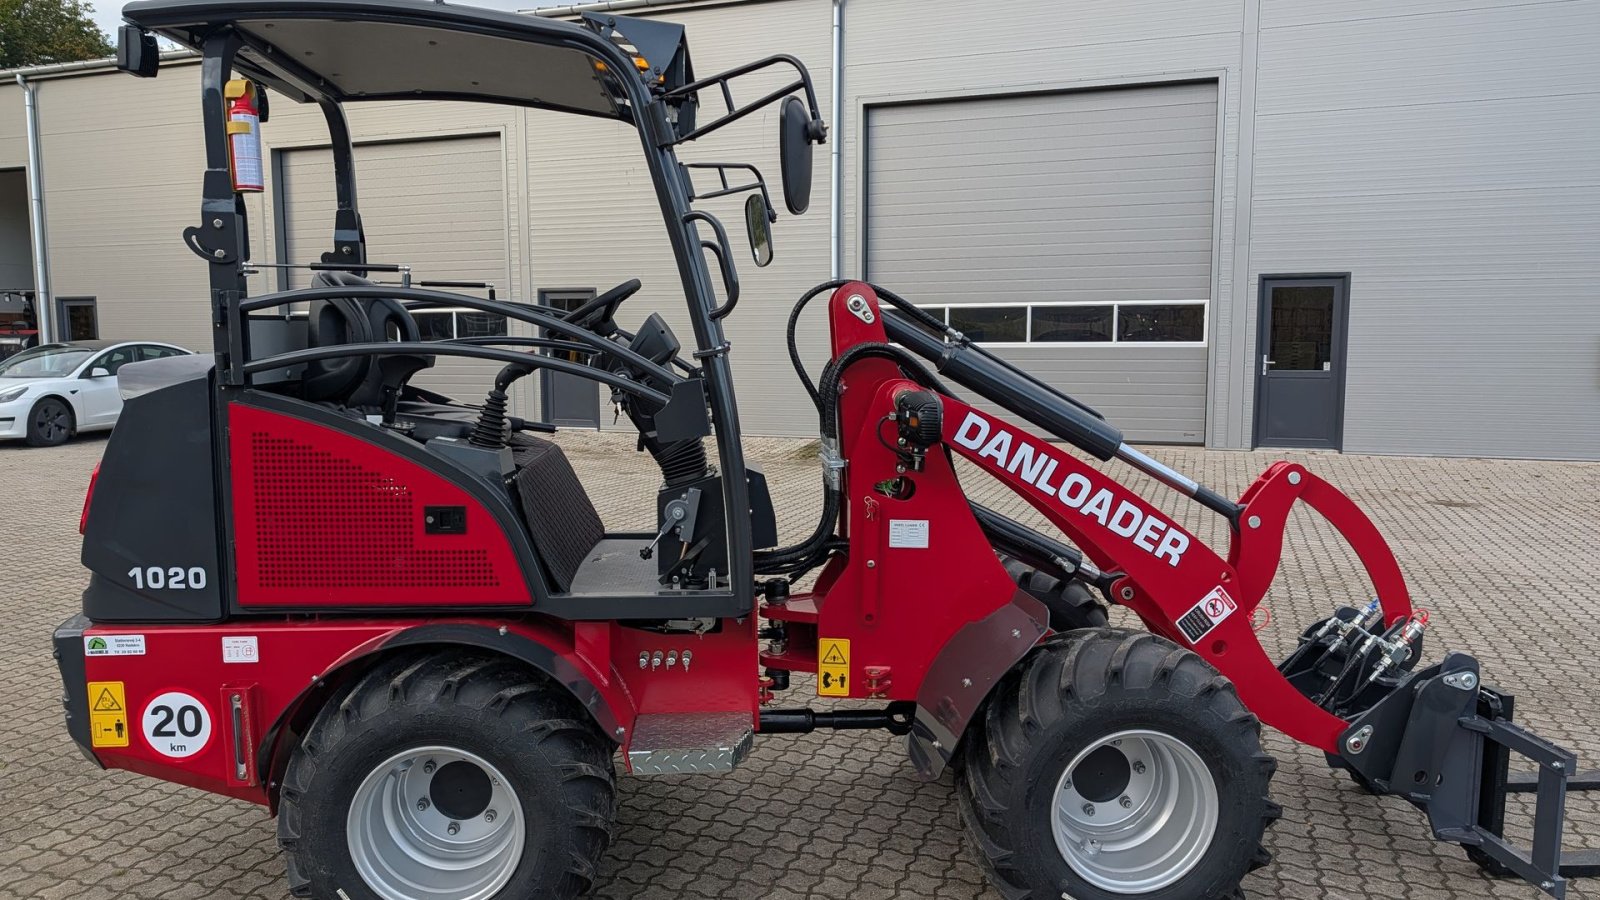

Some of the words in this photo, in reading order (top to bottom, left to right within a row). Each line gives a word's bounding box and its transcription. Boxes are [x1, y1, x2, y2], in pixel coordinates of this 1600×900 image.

[953, 412, 1190, 567] DANLOADER
[128, 567, 206, 590] 1020
[151, 705, 203, 738] 20
[170, 743, 187, 752] km
